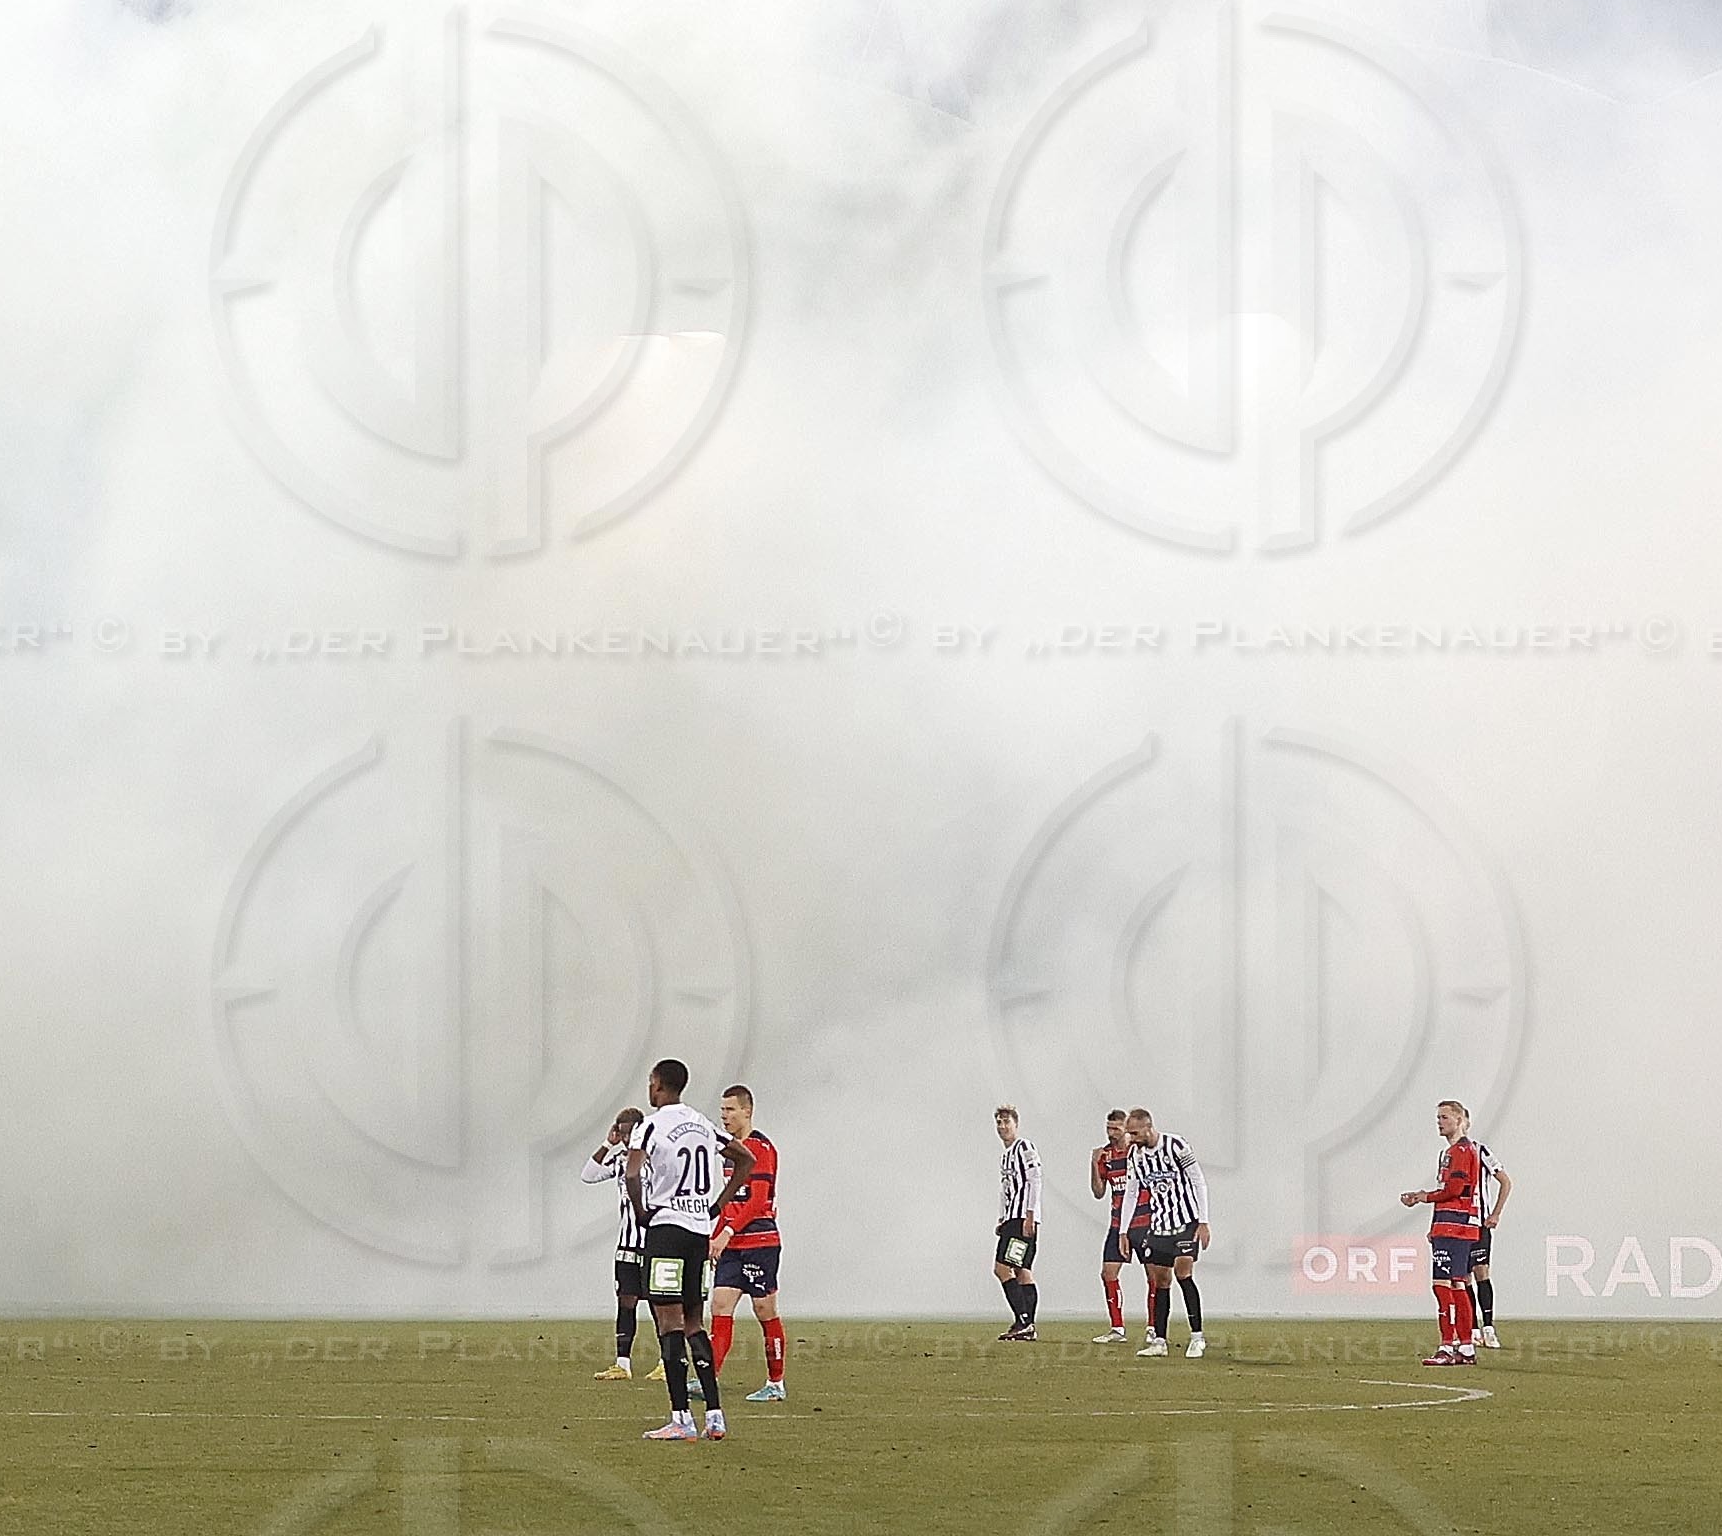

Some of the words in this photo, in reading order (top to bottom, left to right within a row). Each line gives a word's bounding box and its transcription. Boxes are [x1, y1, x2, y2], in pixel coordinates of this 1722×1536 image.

[675, 1144, 711, 1196] 20
[655, 1262, 680, 1286] E
[1302, 1246, 1418, 1283] ORF
